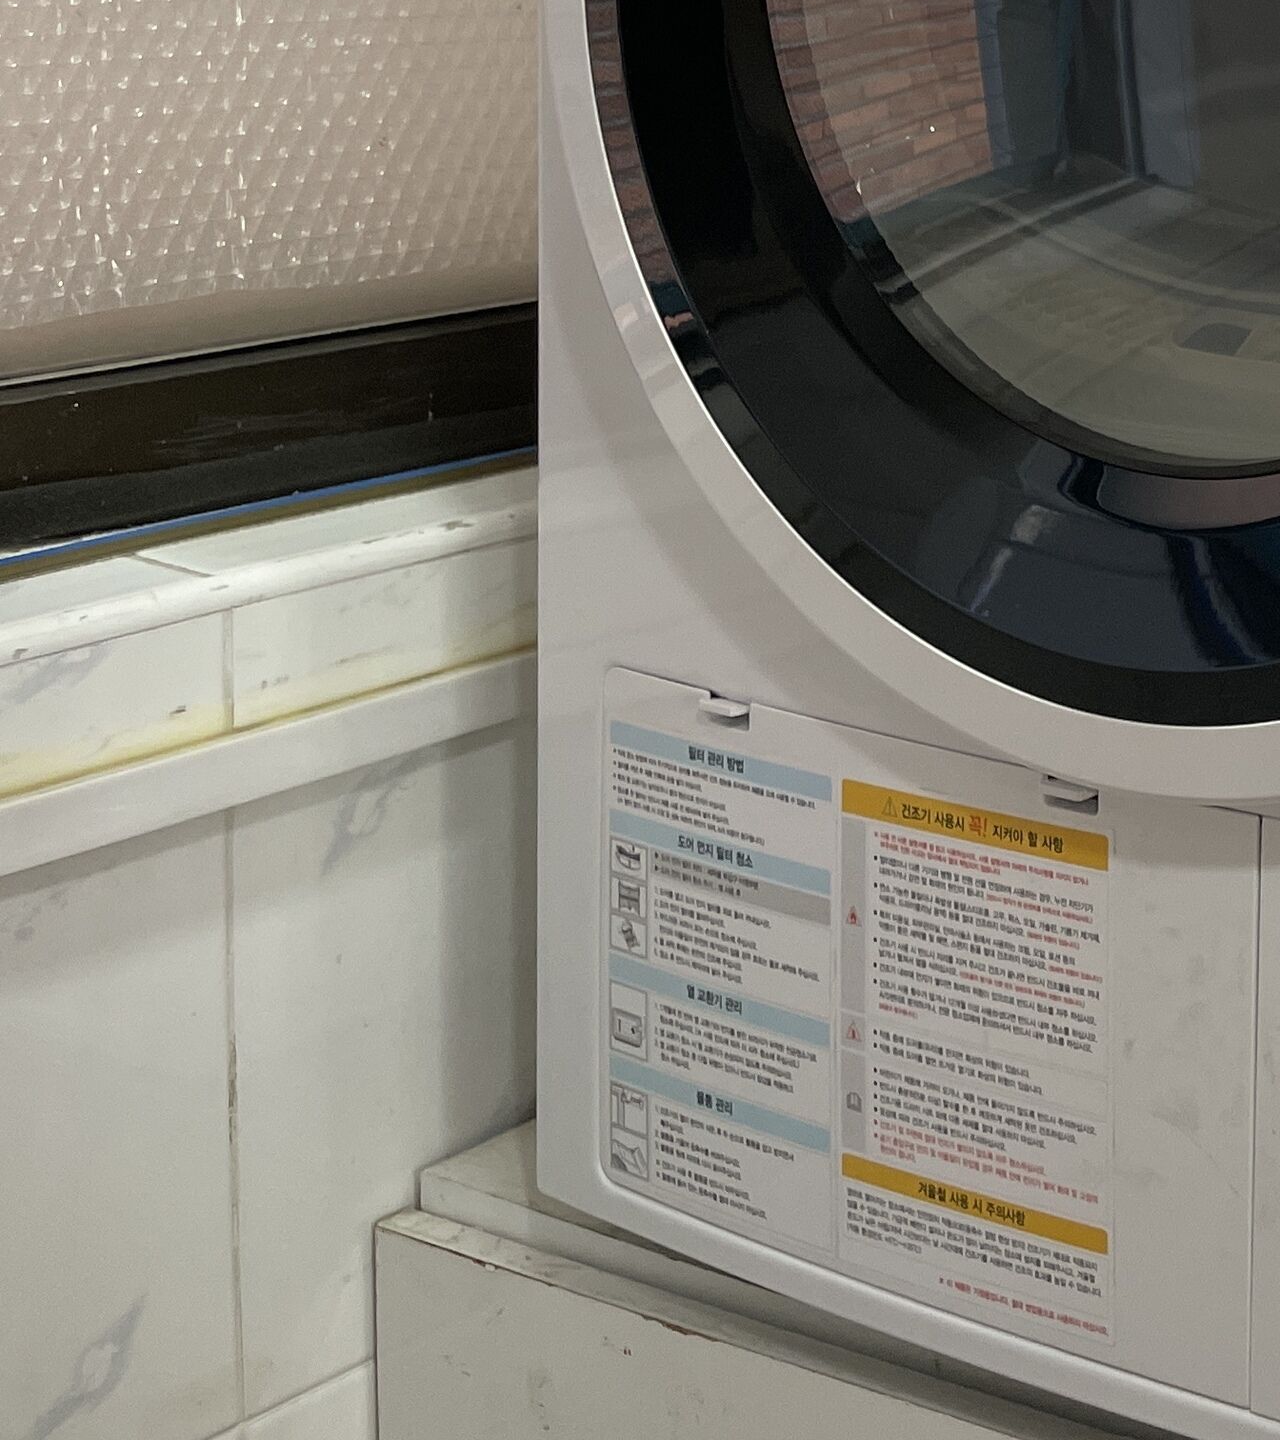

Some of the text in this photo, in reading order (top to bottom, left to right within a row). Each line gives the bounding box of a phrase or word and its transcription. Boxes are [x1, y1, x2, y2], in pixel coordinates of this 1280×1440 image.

[707, 750, 725, 769] 관리
[901, 803, 1064, 854] 건조기 사용시 꼭! 지켜야 할 사항
[725, 996, 743, 1016] 관리
[715, 1097, 733, 1117] 관리
[918, 1181, 1025, 1227] 겨울철 사용 시 주의사항
